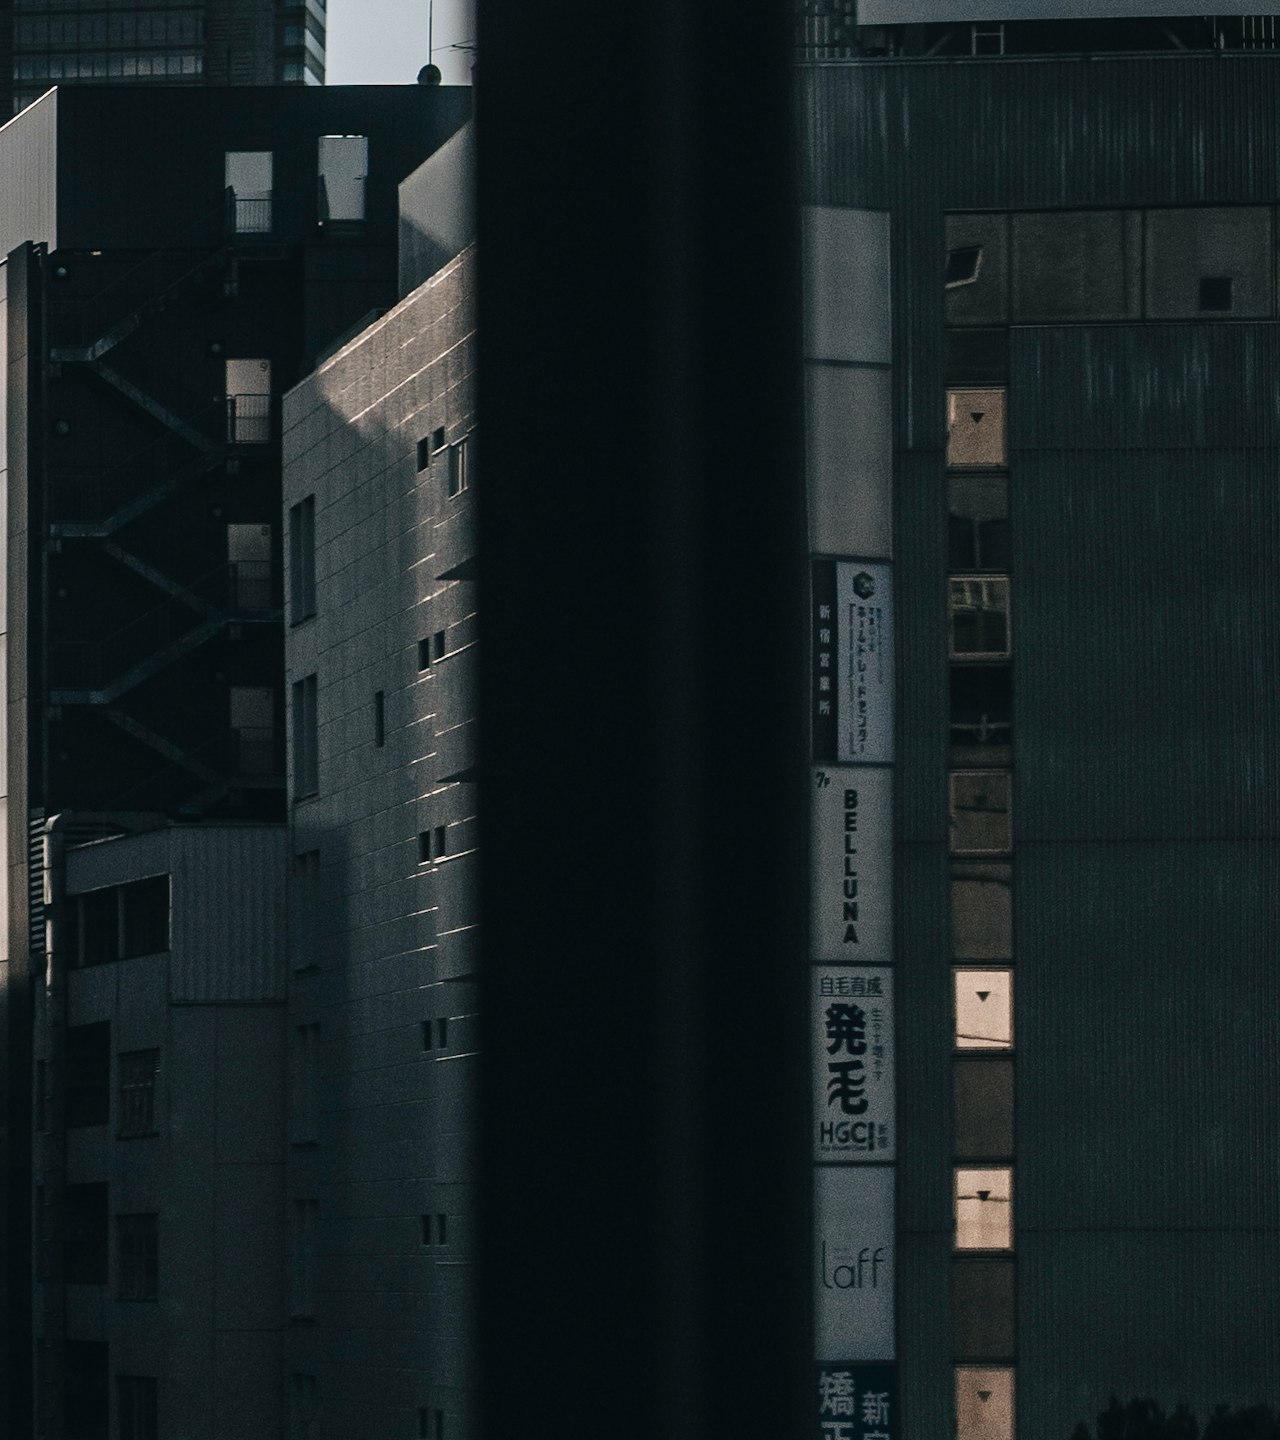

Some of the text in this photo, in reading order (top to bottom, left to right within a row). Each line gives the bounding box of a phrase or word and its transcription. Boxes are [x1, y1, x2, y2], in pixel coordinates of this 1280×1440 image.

[843, 789, 858, 944] BELLUNA
[821, 975, 882, 995] 自毛育成
[825, 1003, 868, 1115] 発毛
[820, 1121, 867, 1144] HGC
[822, 1240, 884, 1289] laff
